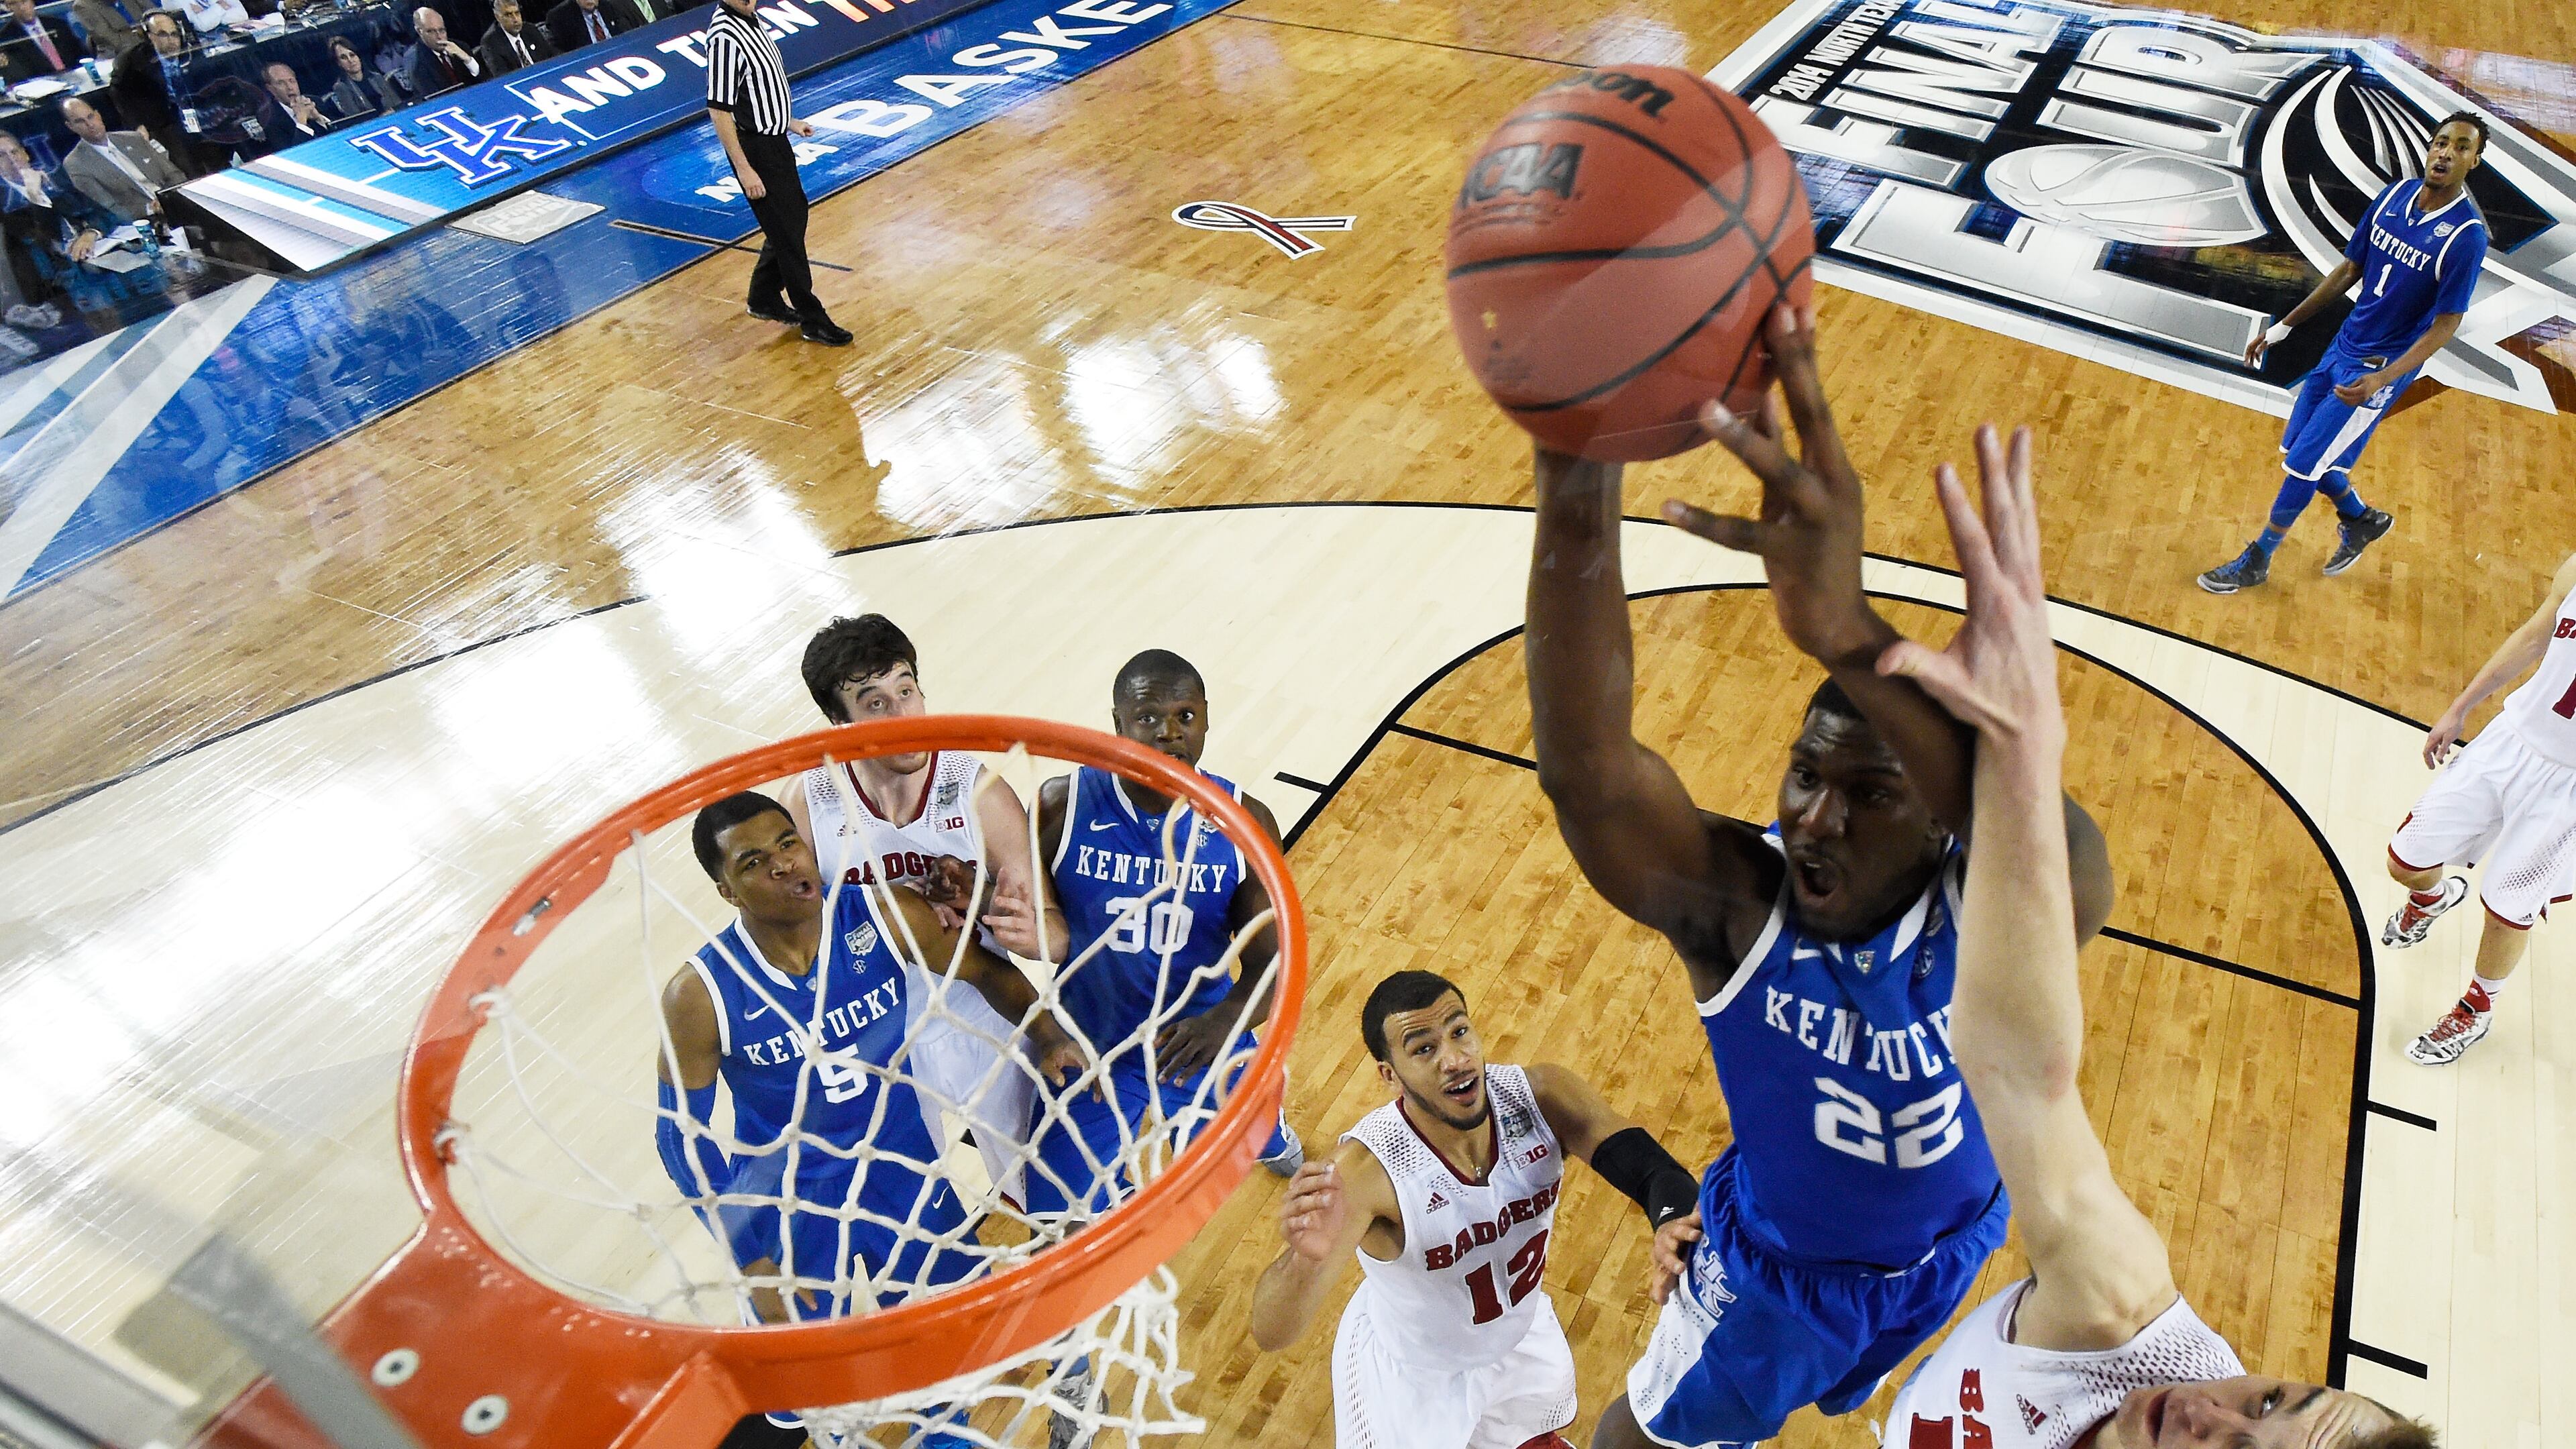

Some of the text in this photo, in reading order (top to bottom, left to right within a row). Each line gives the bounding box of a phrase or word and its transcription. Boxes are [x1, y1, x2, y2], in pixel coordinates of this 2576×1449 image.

[529, 56, 666, 125] AND
[1749, 0, 2065, 187] FINAL
[1769, 63, 1835, 101] 2014
[1803, 21, 1878, 66] NORTH
[2370, 223, 2432, 272] KENTUCKY
[2373, 263, 2393, 298] 1
[1106, 896, 1194, 955] 30
[743, 977, 900, 1066] KENTUCKY
[814, 1042, 869, 1104] 5
[1814, 1077, 1964, 1169] 22
[1426, 1178, 1561, 1272] BADGERS
[1465, 1228, 1549, 1326] 12
[2015, 1393, 2036, 1436] adidas
